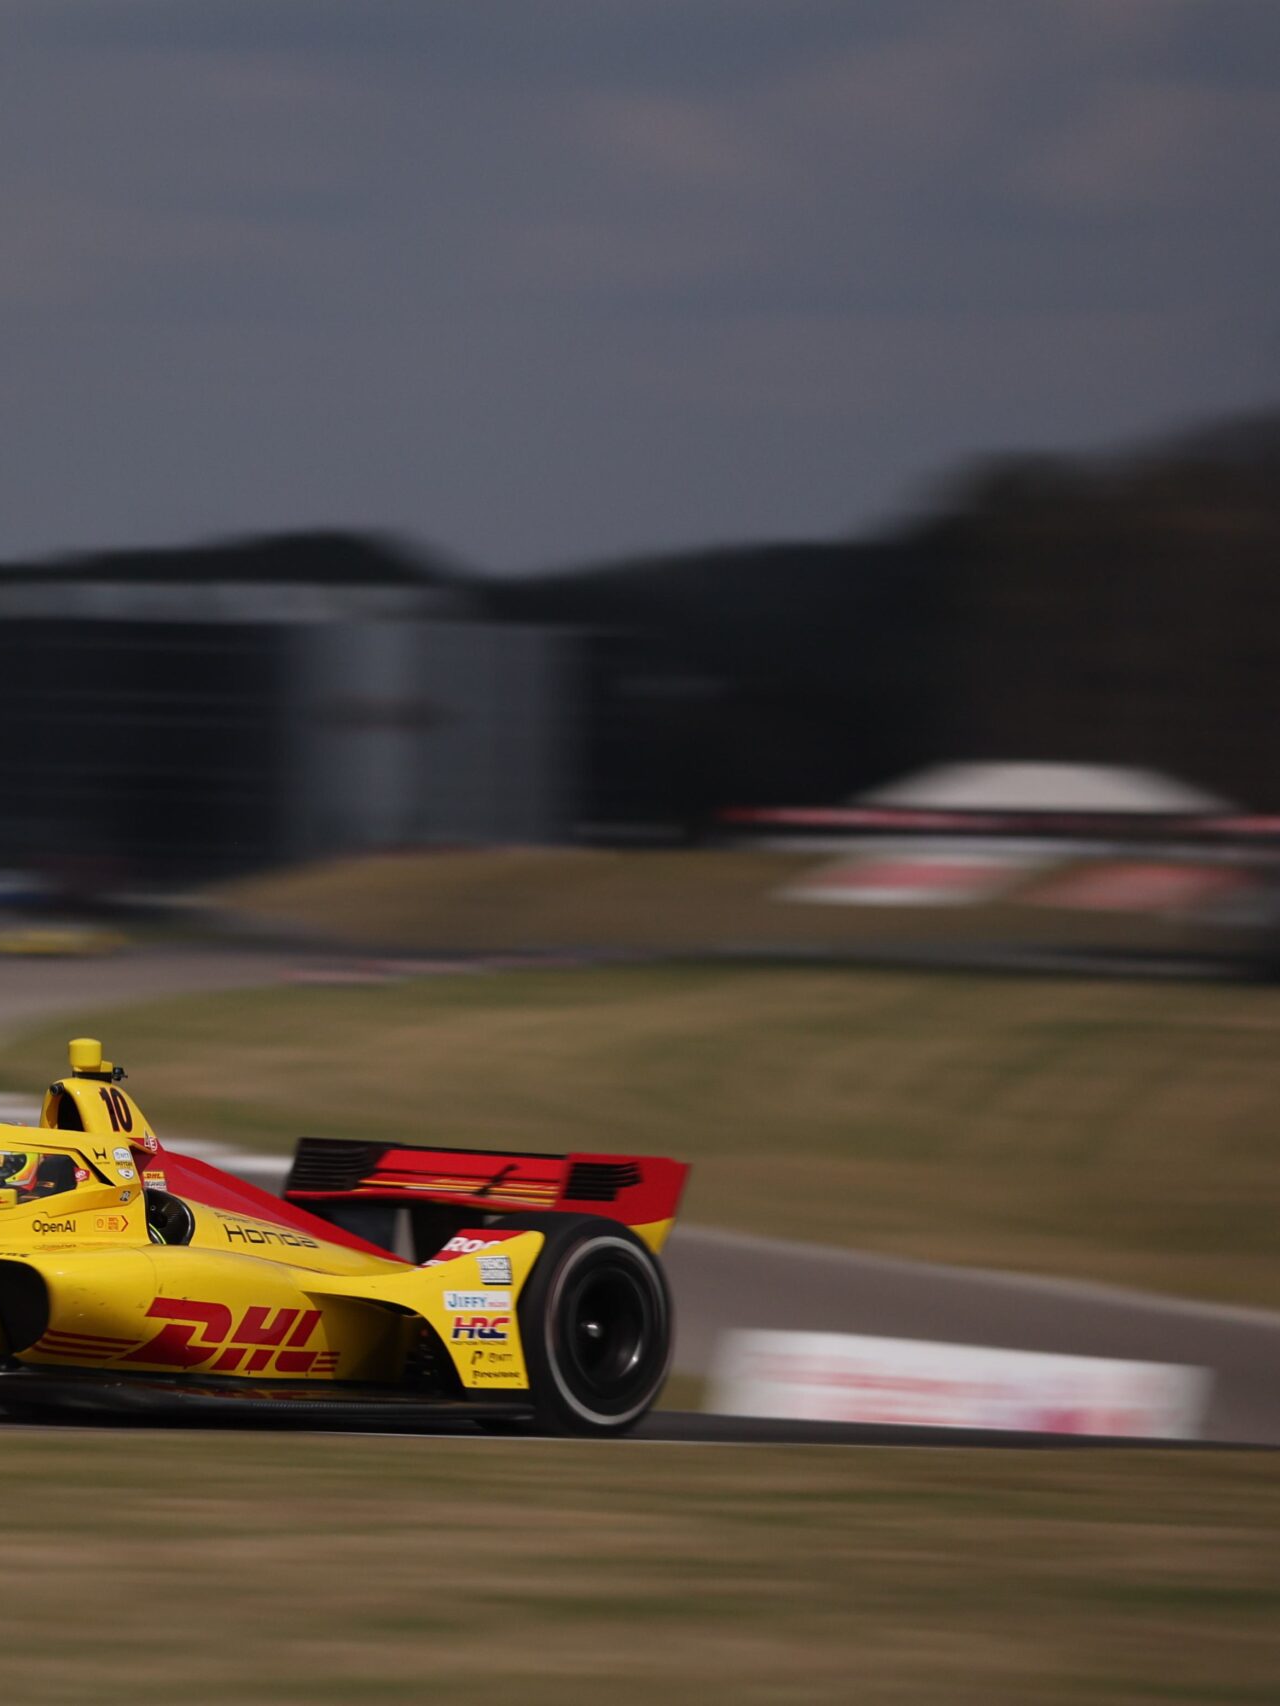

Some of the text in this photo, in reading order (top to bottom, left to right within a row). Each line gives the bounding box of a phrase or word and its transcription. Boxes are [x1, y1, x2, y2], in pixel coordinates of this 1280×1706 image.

[99, 1087, 133, 1133] 10
[32, 1220, 76, 1236] OpenAI
[223, 1223, 320, 1249] Honda
[117, 1297, 323, 1369] DHL
[452, 1317, 511, 1339] HRC
